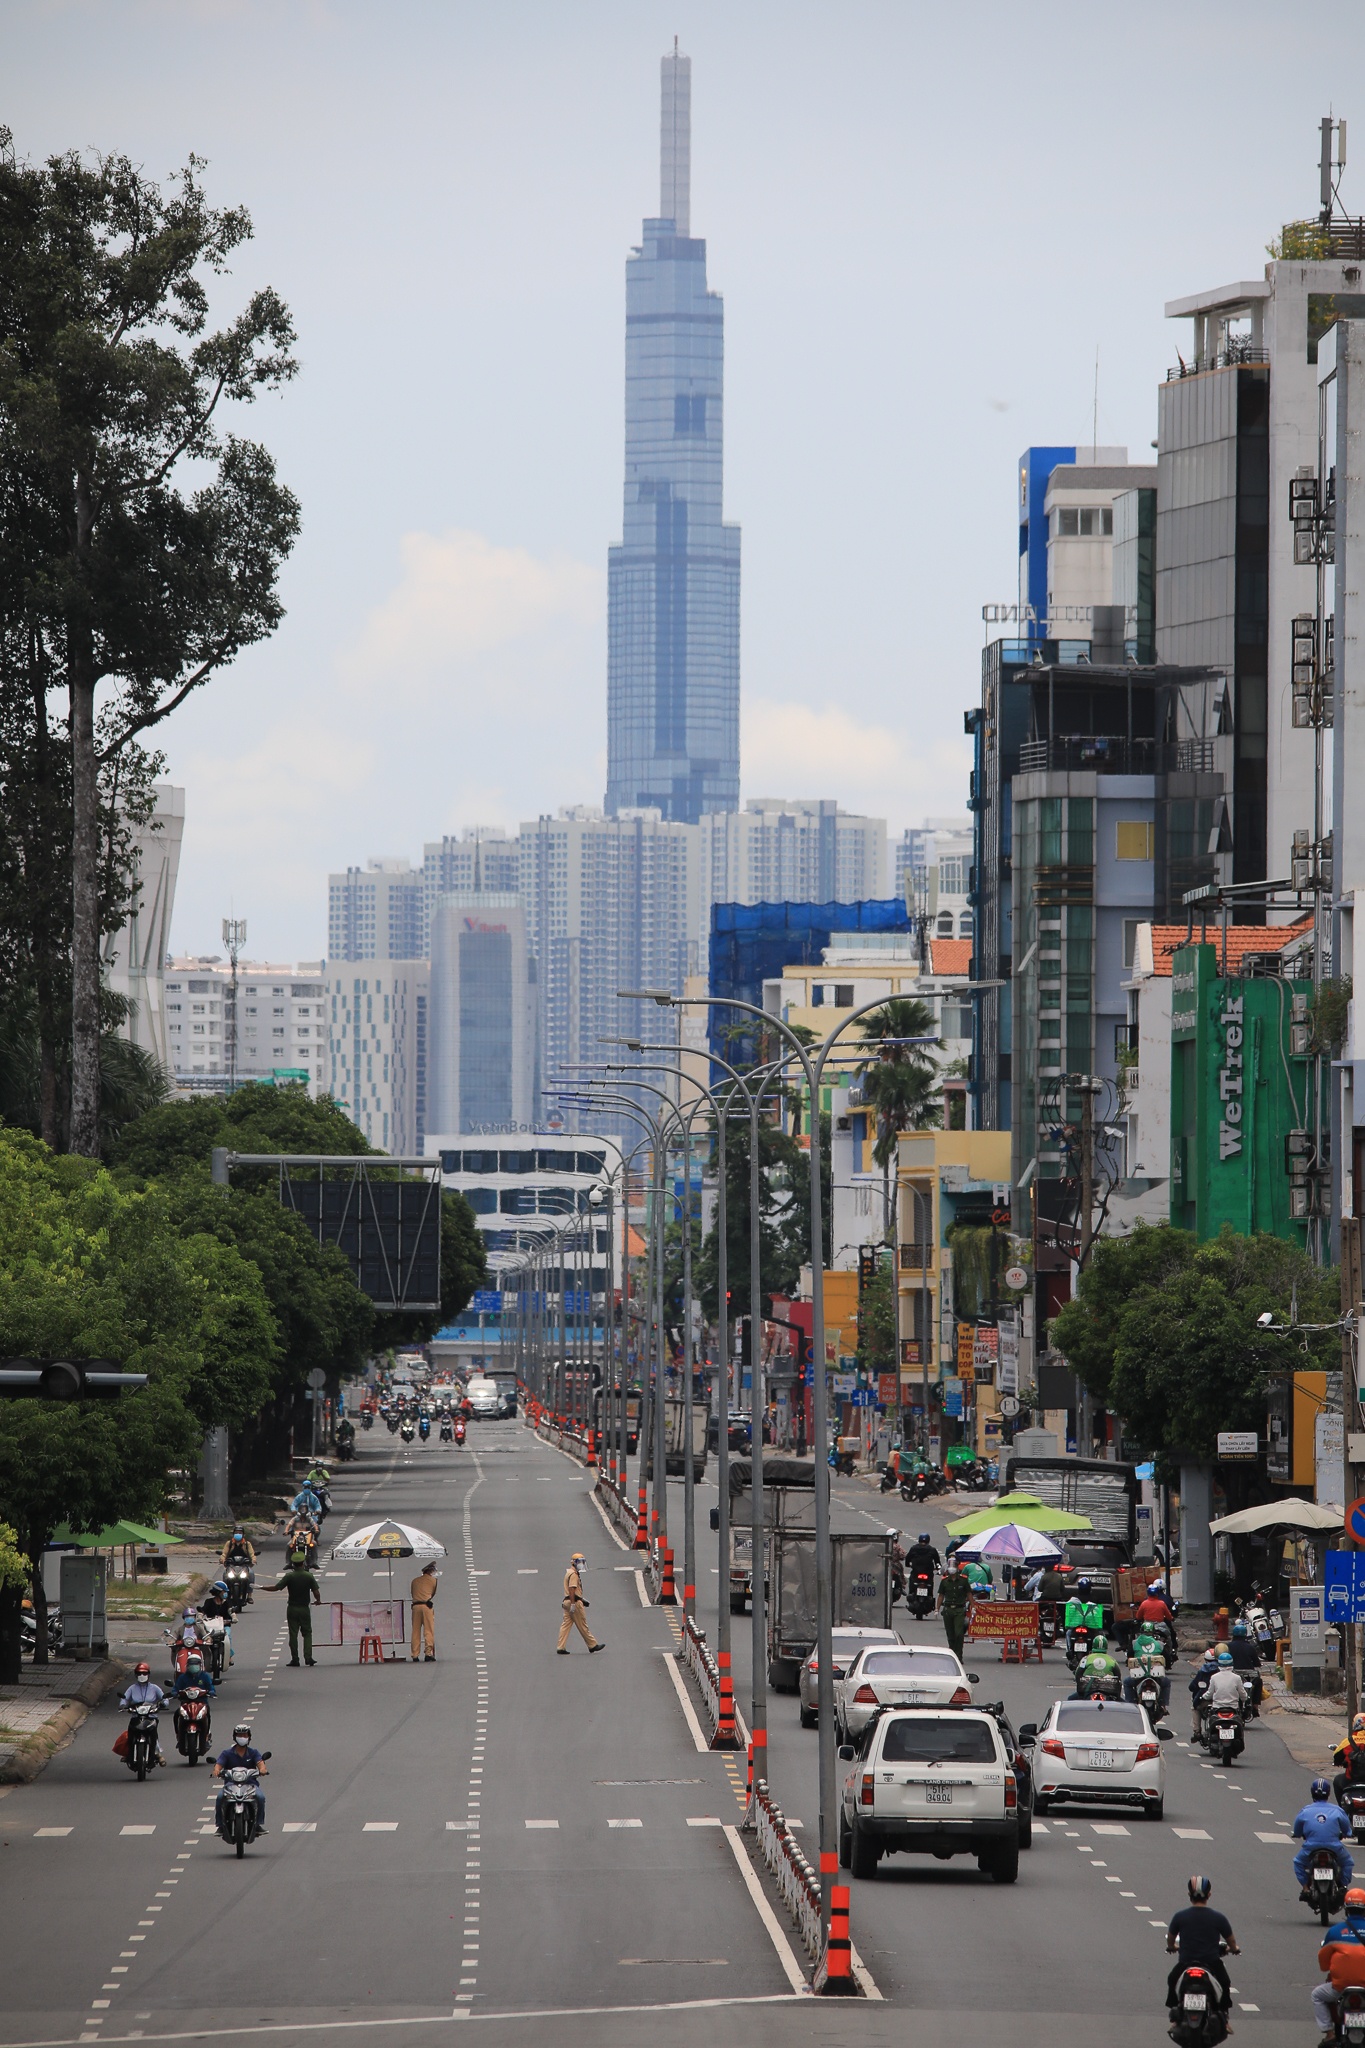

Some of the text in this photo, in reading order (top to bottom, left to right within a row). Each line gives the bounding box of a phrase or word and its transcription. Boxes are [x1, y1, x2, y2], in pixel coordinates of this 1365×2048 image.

[1219, 996, 1244, 1161] WeTrek
[468, 1120, 546, 1133] VietinBank
[961, 1370, 971, 1378] PY
[851, 1586, 877, 1597] 458.03
[975, 1614, 1033, 1625] CHỐT KIỂM SOÁT
[1094, 1751, 1107, 1759] 51G
